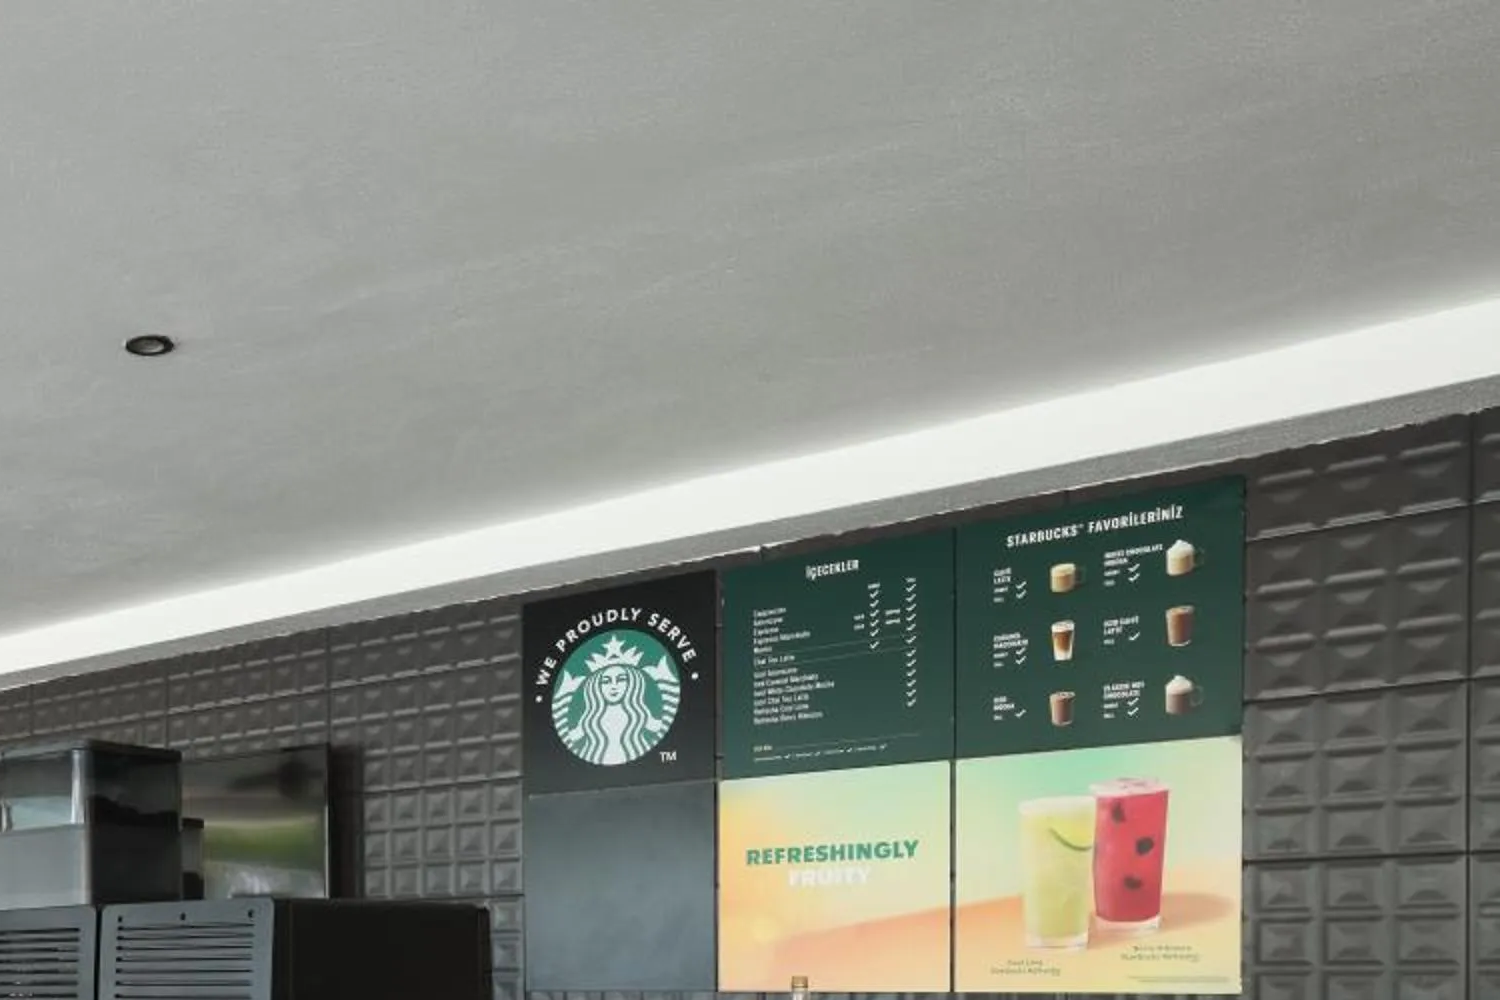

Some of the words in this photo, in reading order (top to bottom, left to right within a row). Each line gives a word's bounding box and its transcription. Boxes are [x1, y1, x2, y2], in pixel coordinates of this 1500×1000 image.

[1006, 525, 1079, 548] STARBUCKS
[536, 657, 557, 686] WE
[555, 607, 642, 653] PROUDLY
[647, 612, 698, 664] SERVE
[746, 839, 920, 866] REFRESHINGLY
